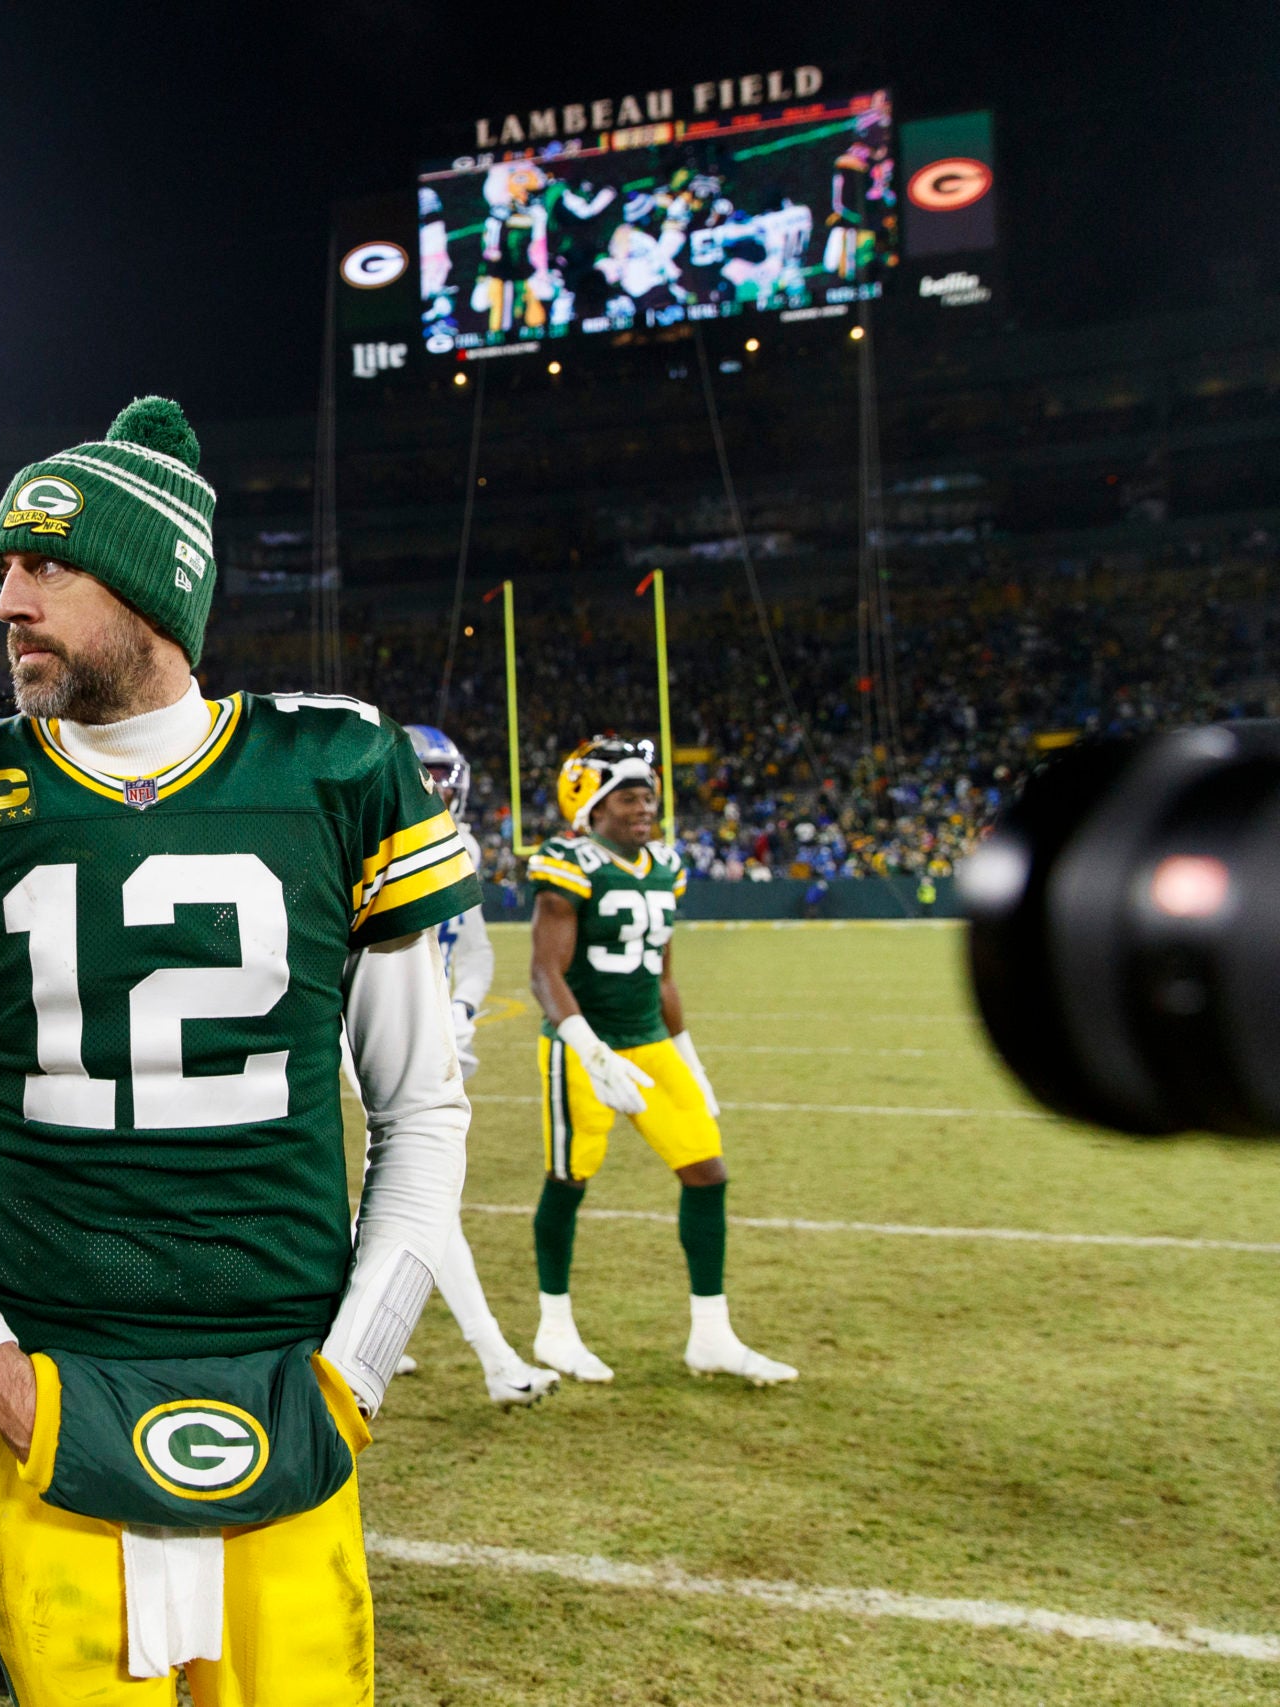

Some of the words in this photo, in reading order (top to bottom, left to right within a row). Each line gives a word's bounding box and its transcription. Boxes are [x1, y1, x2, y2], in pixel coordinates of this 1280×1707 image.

[476, 88, 673, 148] LAMBEAU
[693, 65, 823, 114] FIELD
[352, 341, 408, 378] Lite
[17, 479, 78, 515] G
[42, 521, 63, 531] NFC
[271, 691, 381, 727] 1
[129, 788, 154, 801] NFL
[587, 890, 677, 975] 35
[3, 853, 291, 1130] 12
[145, 1411, 254, 1486] G
